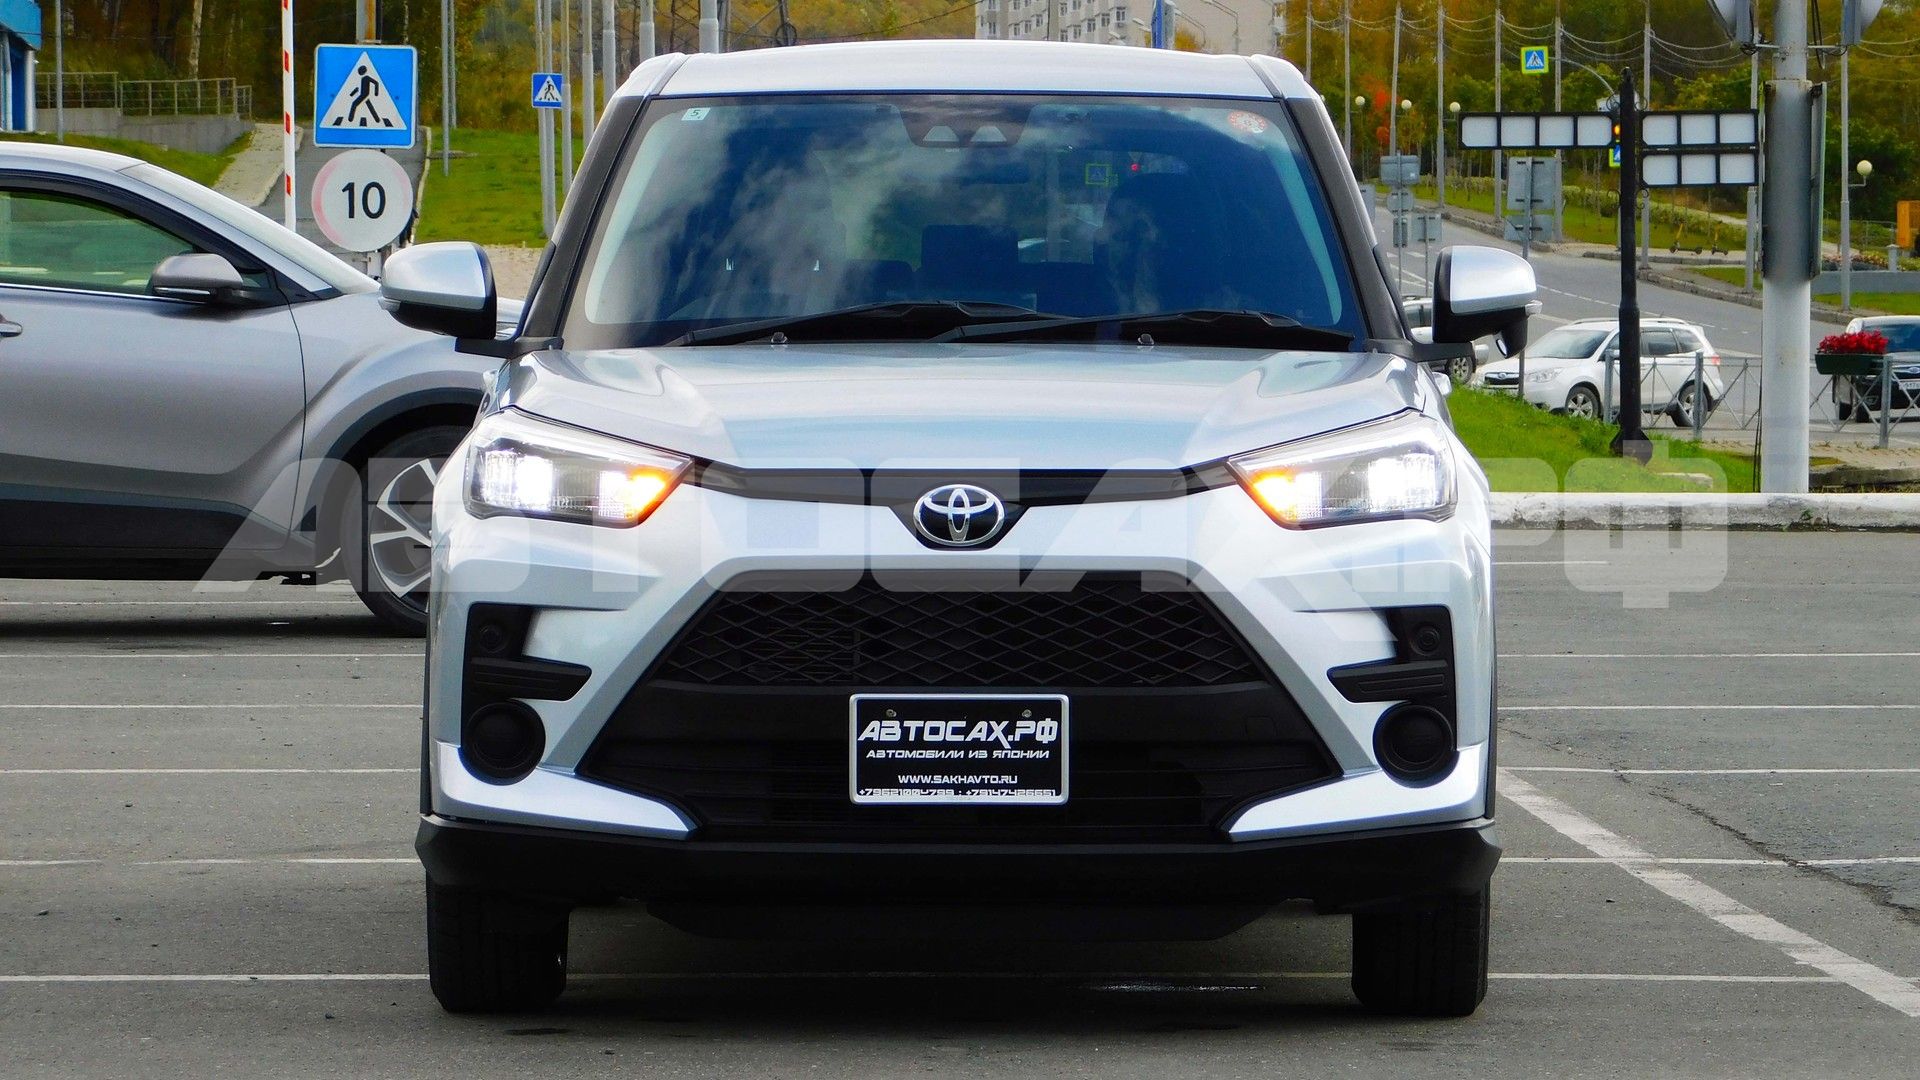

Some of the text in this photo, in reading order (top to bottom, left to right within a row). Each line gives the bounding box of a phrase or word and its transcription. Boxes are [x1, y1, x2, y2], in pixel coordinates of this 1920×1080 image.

[341, 181, 386, 219] 10
[858, 718, 1058, 749] АВТОСАХ.РФ
[866, 750, 1050, 759] АВТОМОБИЛИ ИЗ ЯПОНИИ
[898, 775, 1018, 784] WWW.SAKHAVTO.RU
